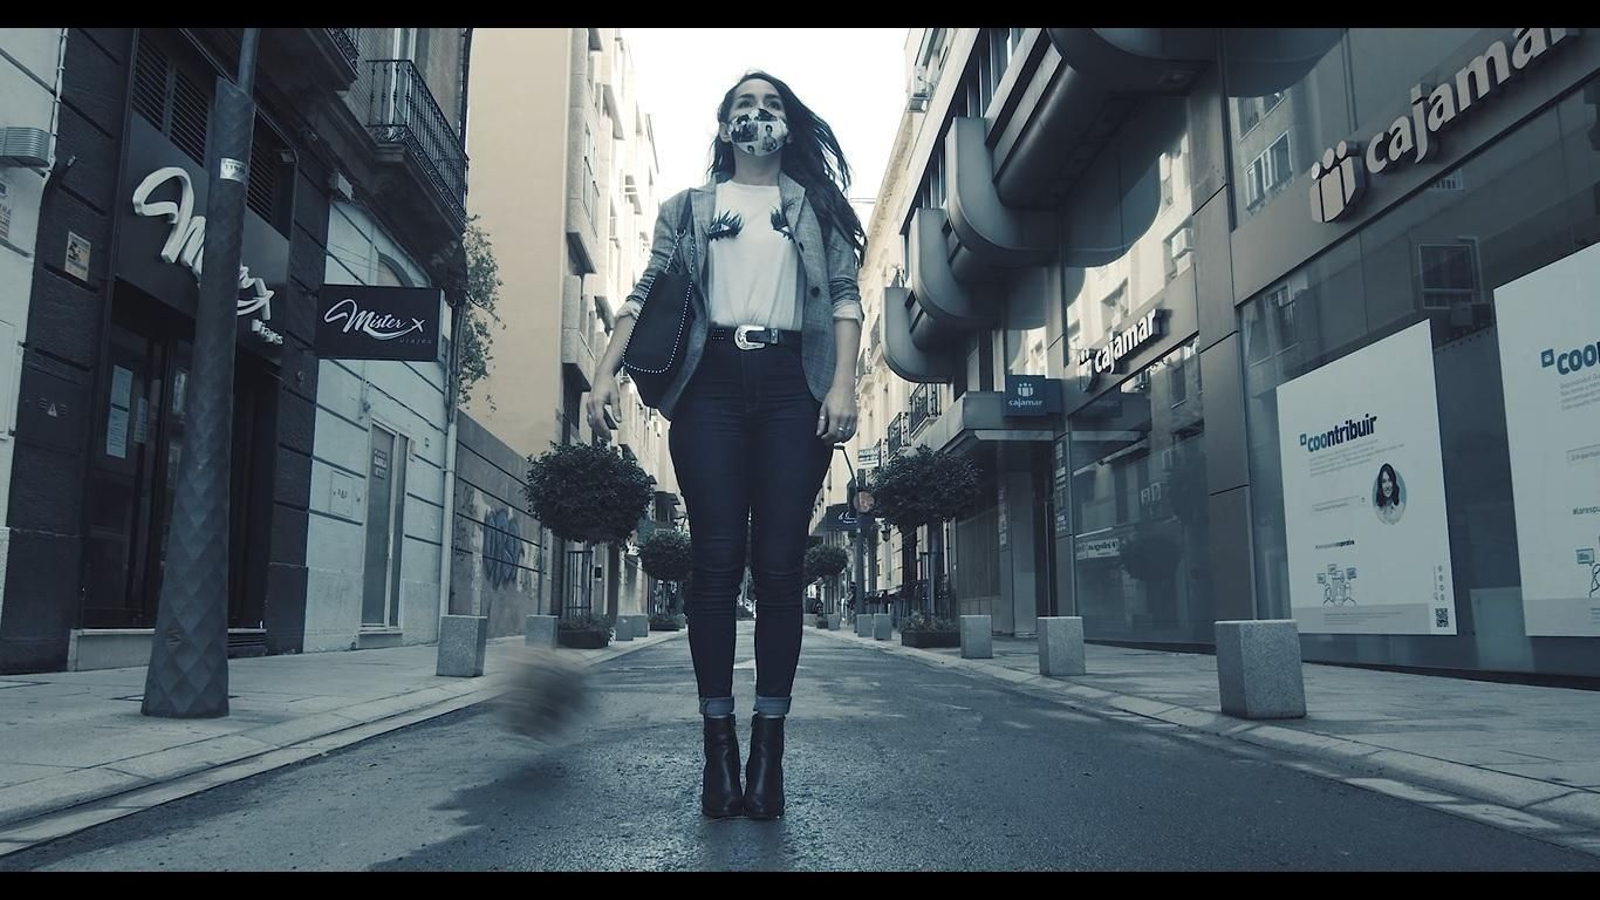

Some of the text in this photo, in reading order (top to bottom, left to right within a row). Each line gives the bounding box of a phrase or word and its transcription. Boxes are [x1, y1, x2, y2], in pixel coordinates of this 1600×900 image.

[324, 299, 406, 336] Mister
[1094, 308, 1156, 375] cajamar
[1557, 342, 1600, 376] coo
[1009, 398, 1043, 408] cajamar
[1307, 413, 1377, 452] coontribuir
